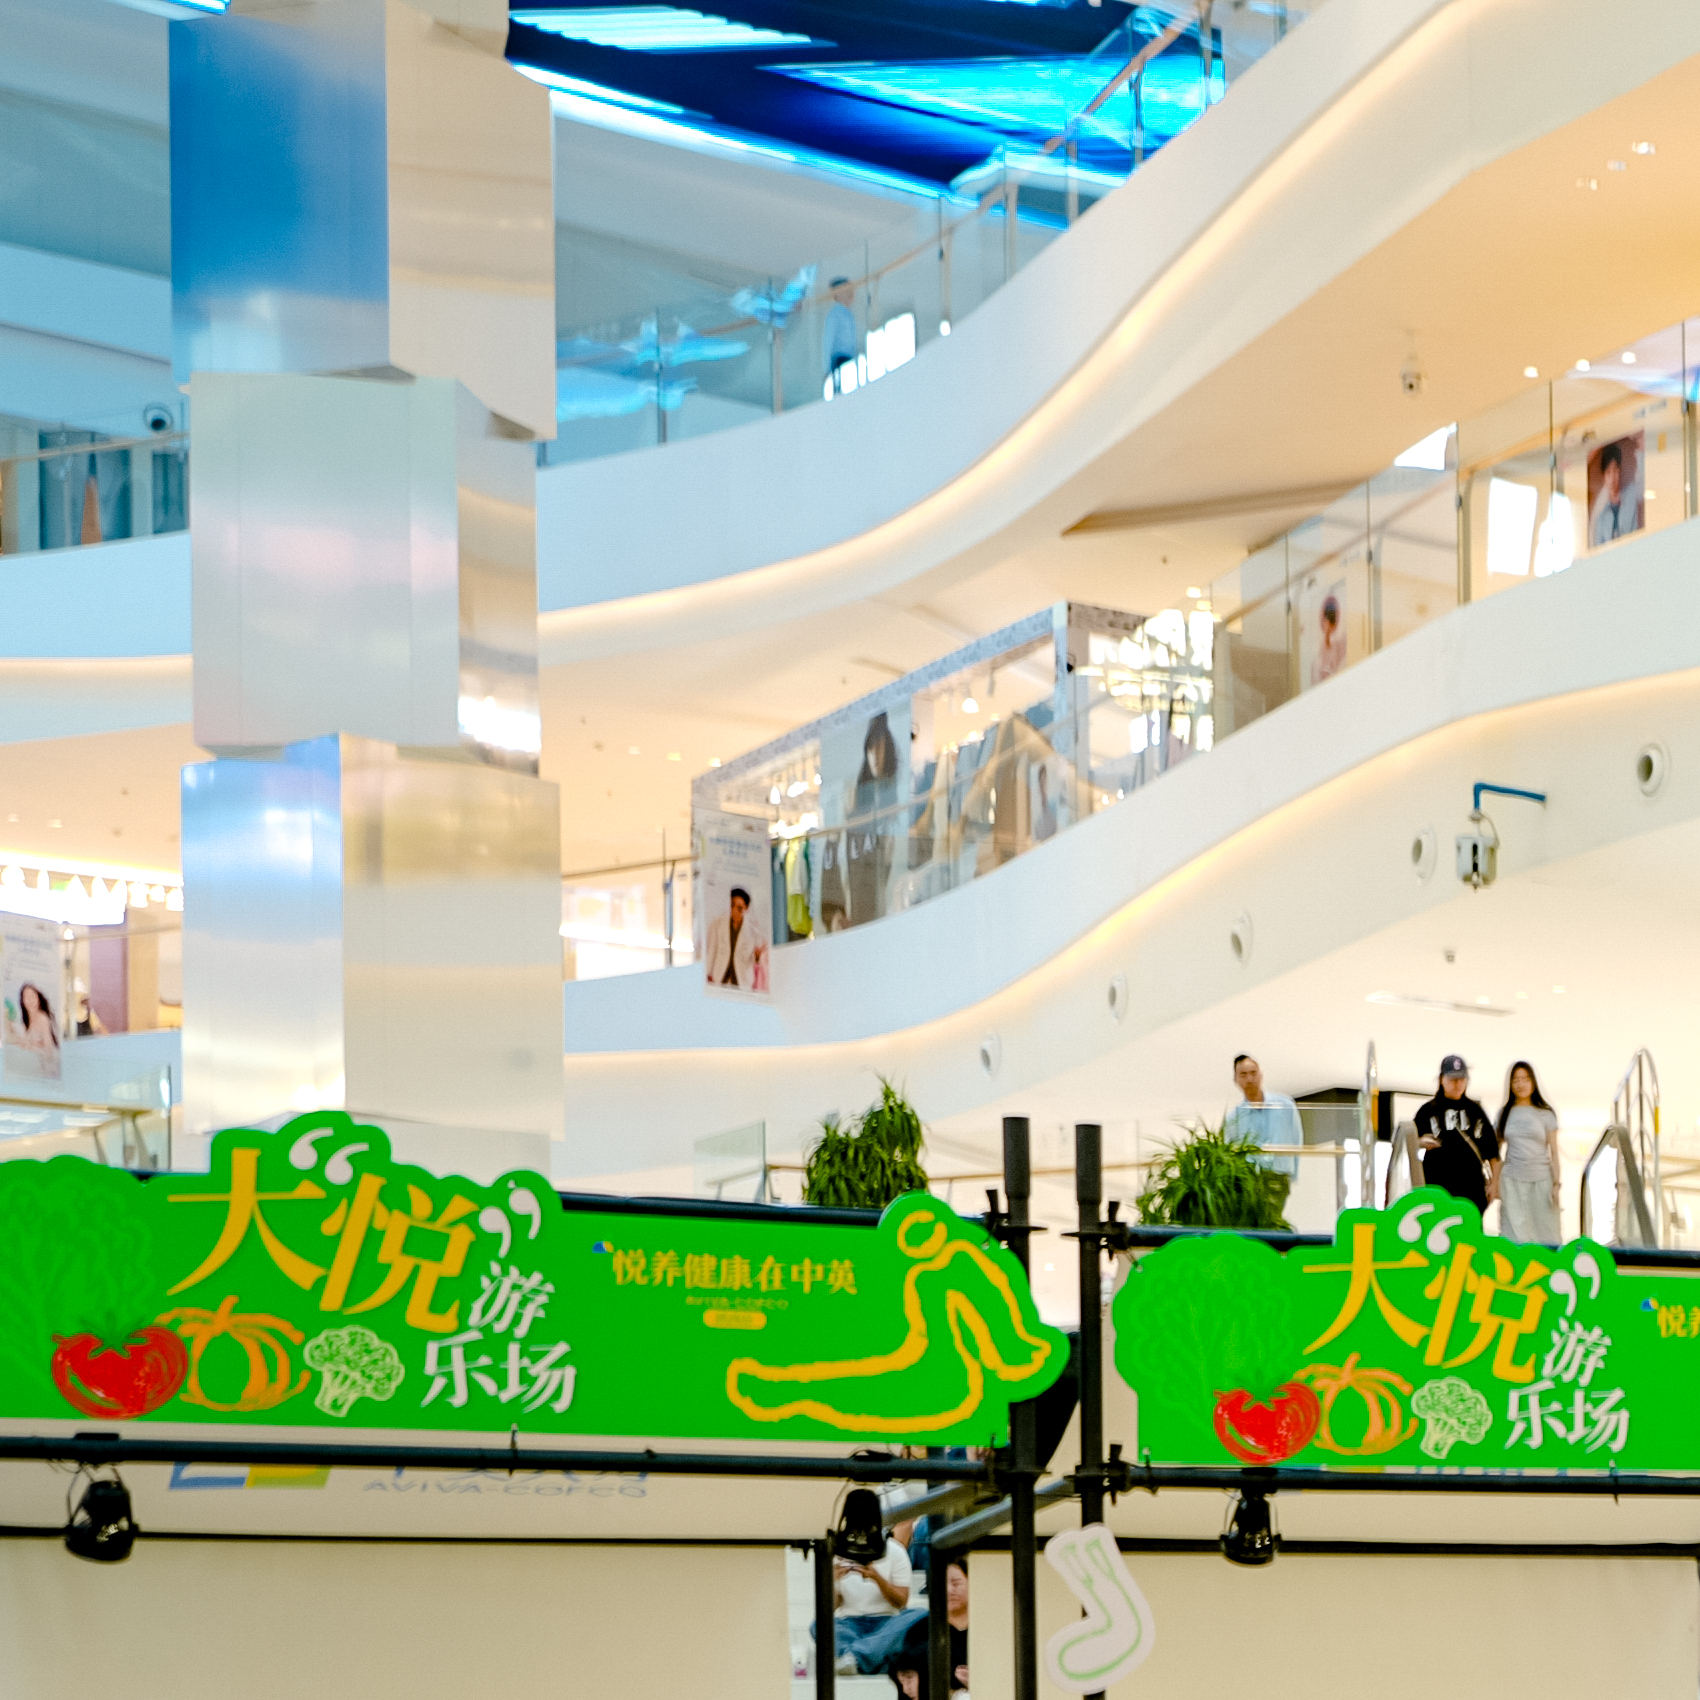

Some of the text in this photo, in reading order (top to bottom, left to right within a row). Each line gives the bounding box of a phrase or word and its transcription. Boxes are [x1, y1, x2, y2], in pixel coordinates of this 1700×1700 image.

[612, 1249, 858, 1294] 悦养健康在中英
